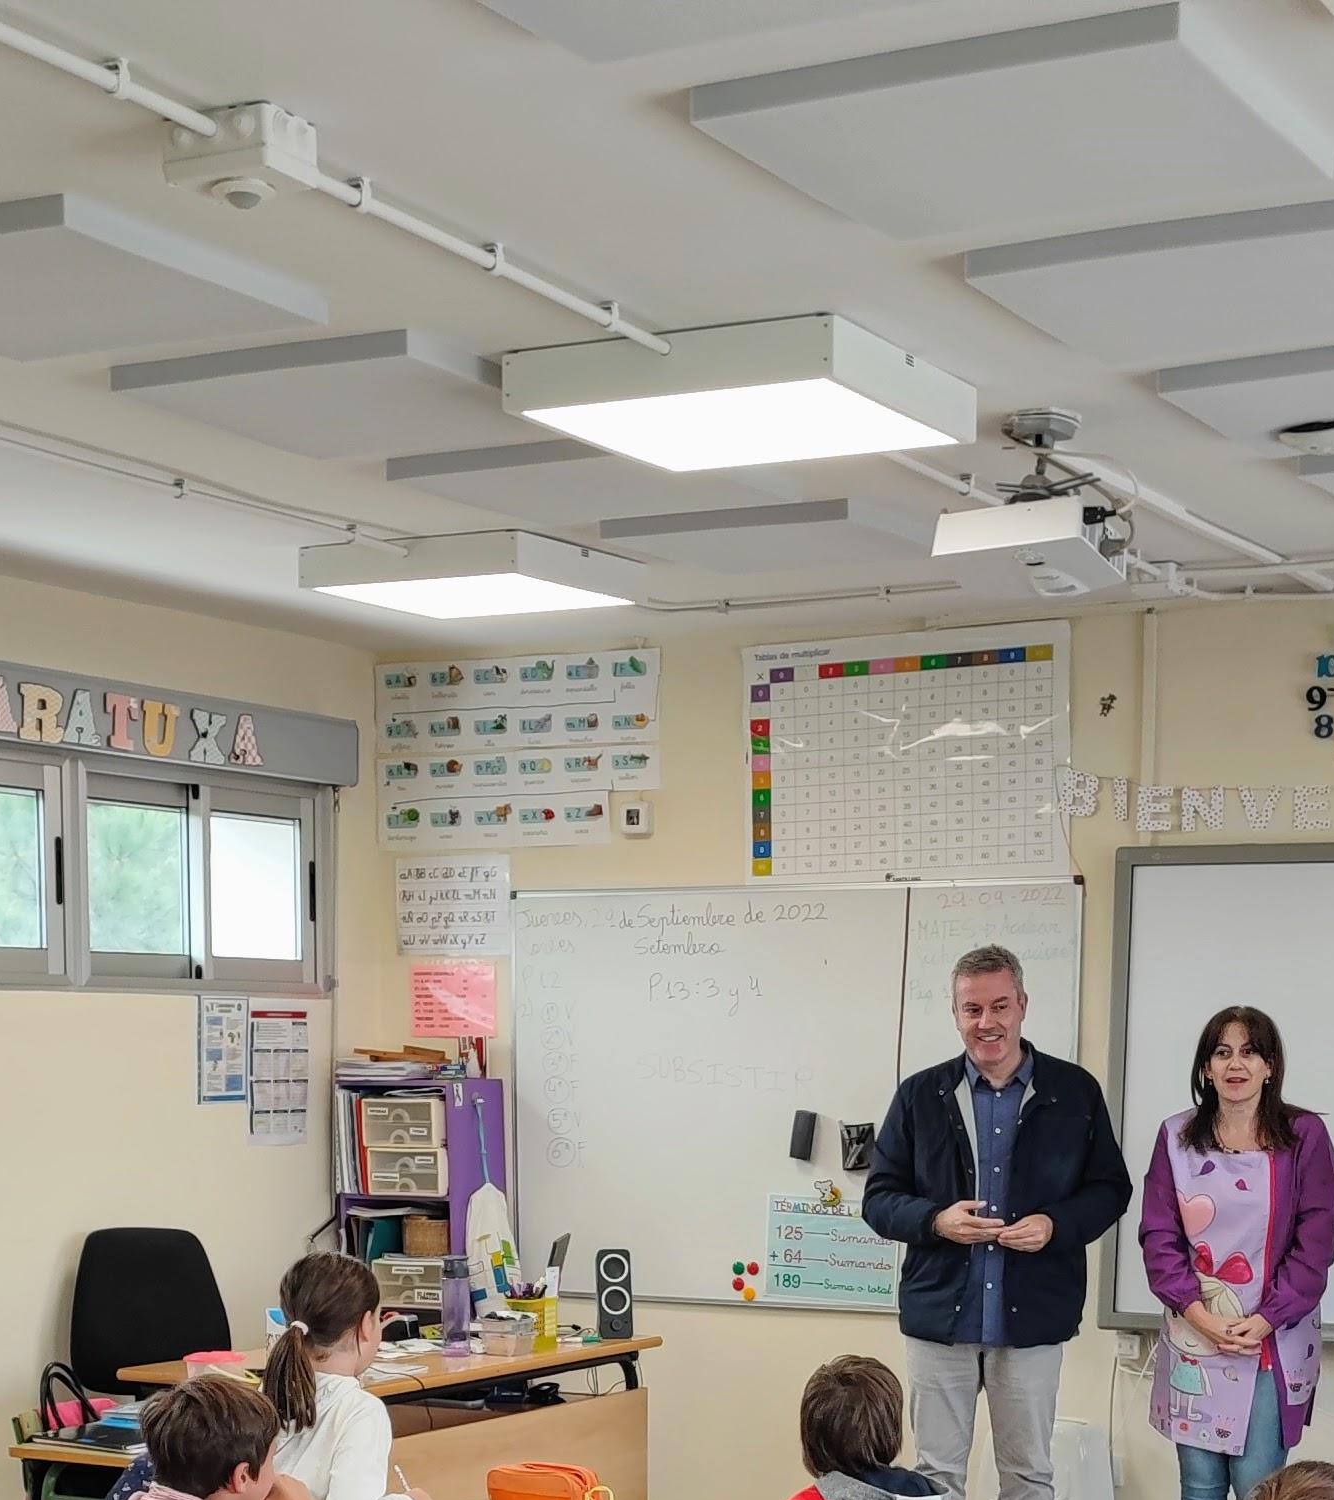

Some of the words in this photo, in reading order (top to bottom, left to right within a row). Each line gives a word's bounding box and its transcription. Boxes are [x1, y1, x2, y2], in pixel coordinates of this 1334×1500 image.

[754, 653, 777, 662] Tablas
[780, 652, 789, 660] de
[791, 649, 831, 660] multiplicar
[1306, 686, 1327, 711] 9
[1314, 714, 1334, 738] 8
[619, 911, 635, 930] de
[635, 902, 736, 936] Septiembre
[743, 900, 766, 925] de
[774, 902, 829, 922] 2022
[728, 989, 739, 1017] y
[748, 976, 763, 998] 4
[775, 1225, 804, 1241] 125
[783, 1248, 803, 1264] 64
[828, 1253, 894, 1270] Sumando
[774, 1273, 801, 1289] 189
[823, 1278, 855, 1291] Suma
[867, 1283, 893, 1295] total
